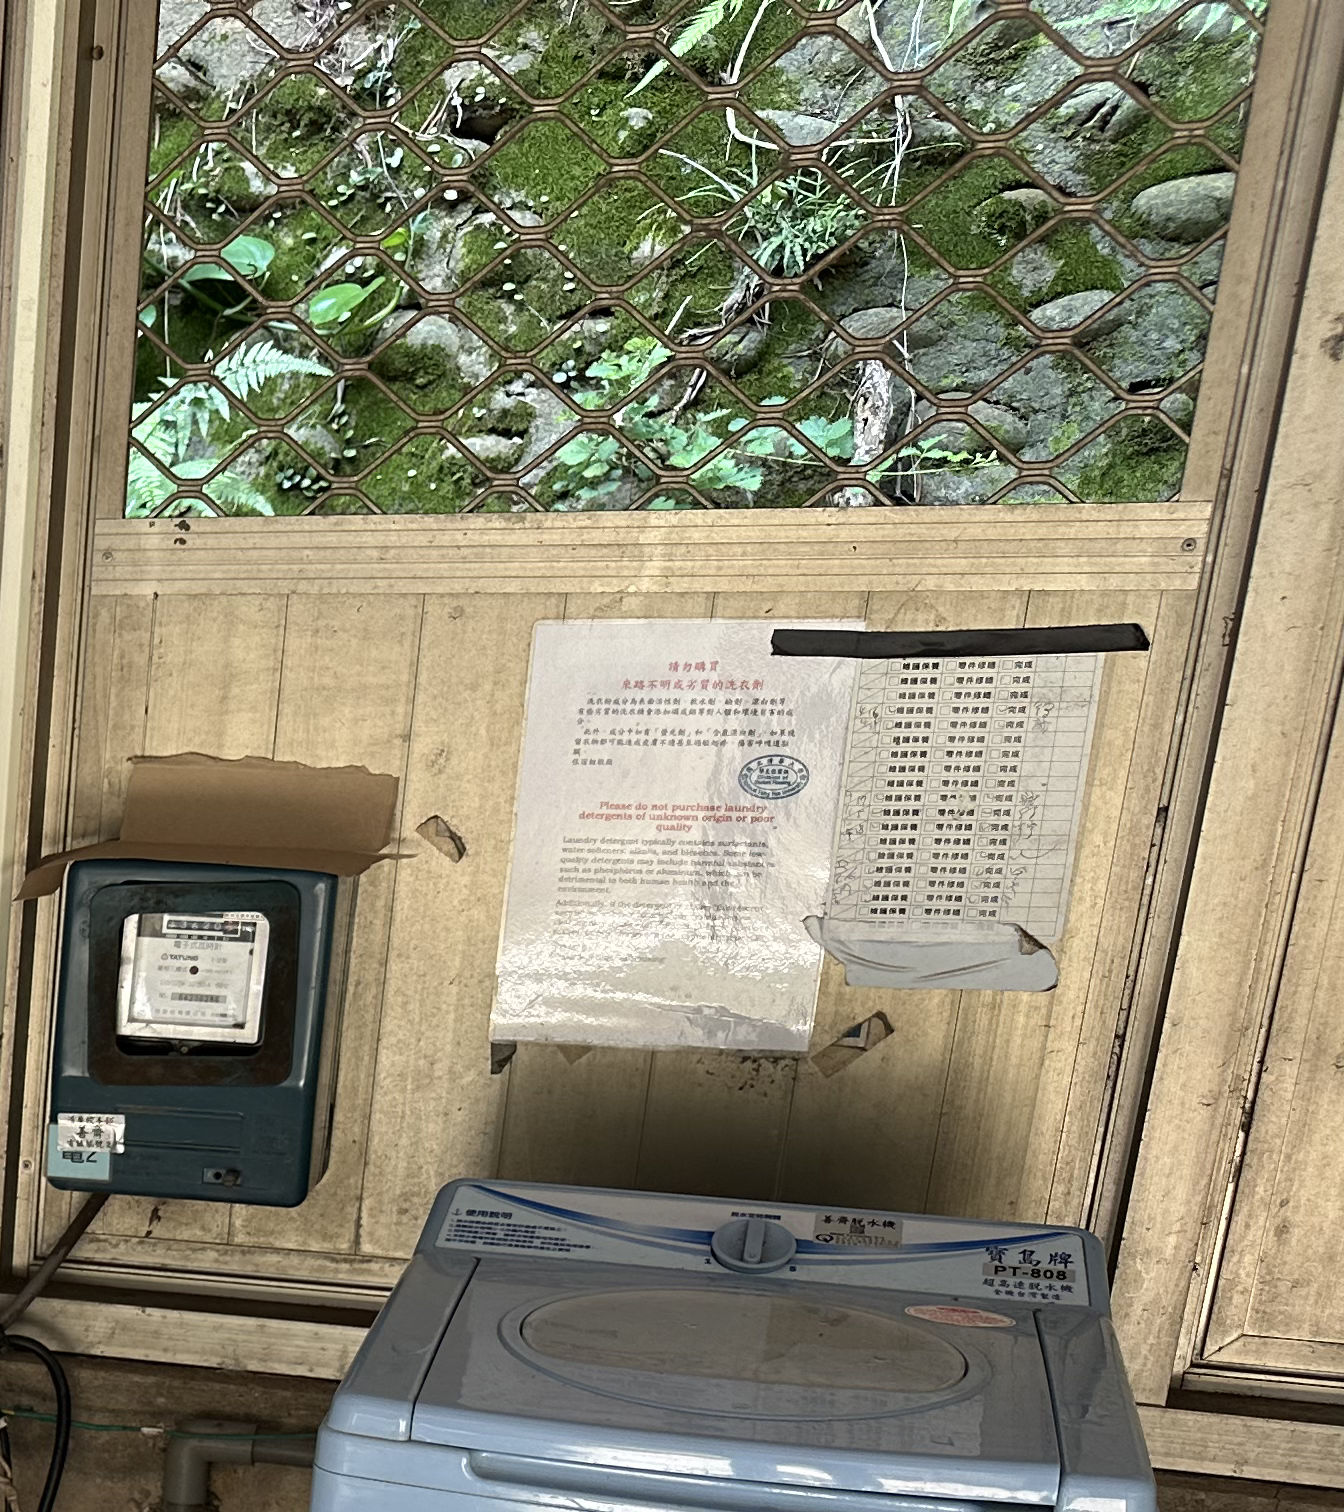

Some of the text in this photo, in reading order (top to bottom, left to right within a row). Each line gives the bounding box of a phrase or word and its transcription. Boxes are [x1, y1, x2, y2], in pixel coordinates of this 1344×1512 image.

[669, 661, 719, 672] 請勿購買
[623, 679, 764, 691] 來路不明或劣質的洗衣劑
[600, 801, 767, 814] Please do not purchase laundry
[579, 811, 775, 824] detergents of unknown origin or poor
[656, 823, 692, 833] quality
[563, 836, 598, 845] Laundry
[465, 1209, 513, 1220] 使用說明
[984, 1246, 1074, 1269] 寶島牌
[993, 1265, 1067, 1281] PT-808
[982, 1278, 1074, 1293] 超高速脫水機
